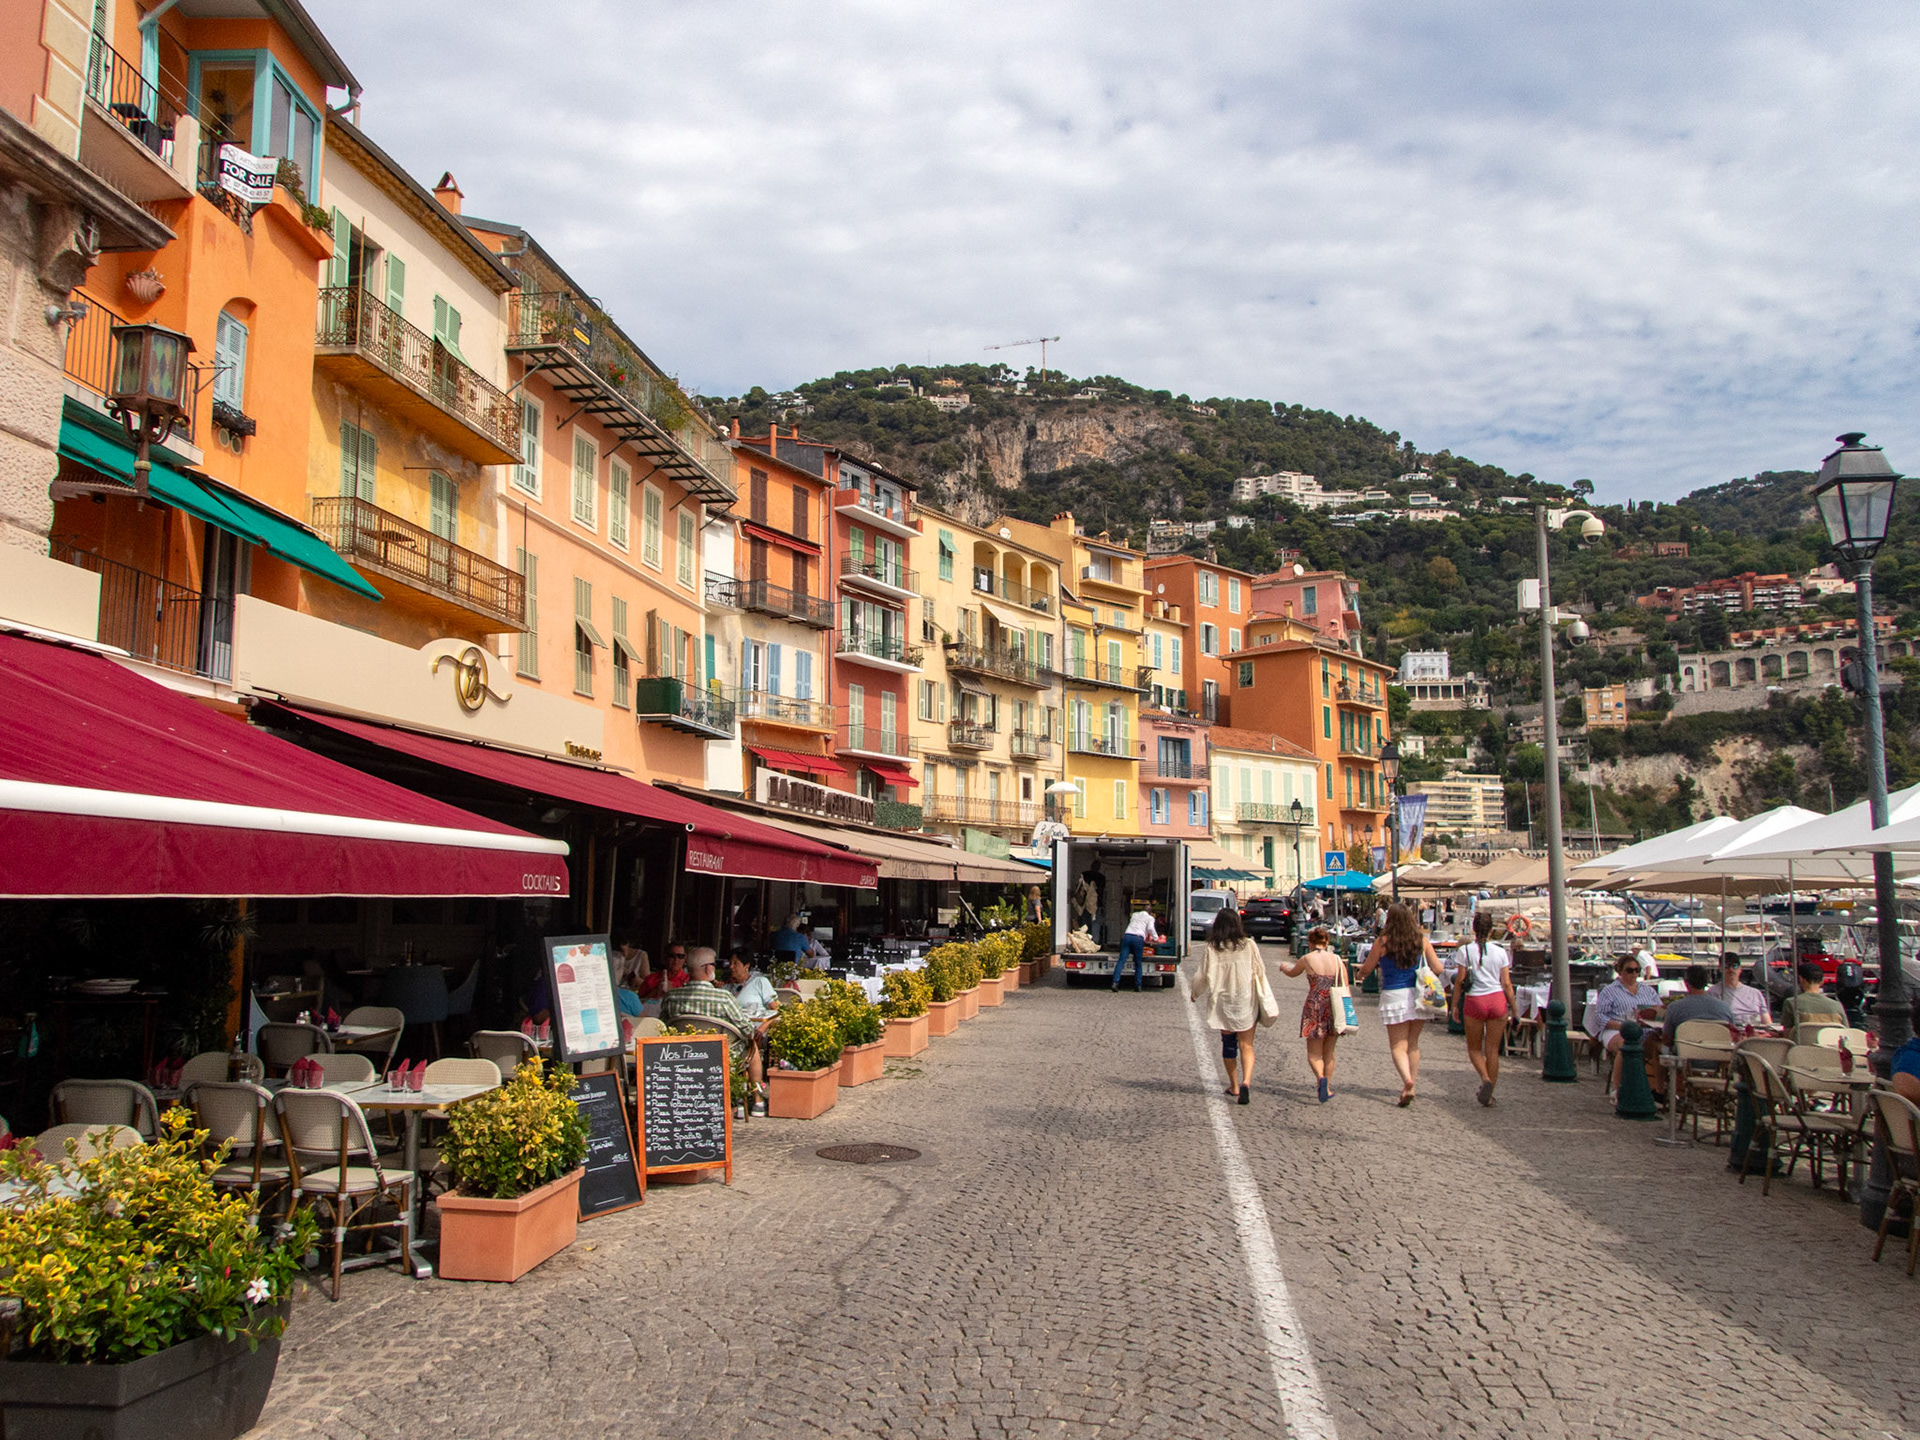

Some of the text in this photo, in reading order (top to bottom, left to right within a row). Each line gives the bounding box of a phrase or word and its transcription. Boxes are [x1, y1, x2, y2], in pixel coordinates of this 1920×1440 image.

[223, 160, 273, 187] FOR SALE
[689, 850, 725, 871] RESTAURANT
[522, 873, 561, 891] COCKTAILS
[660, 1044, 681, 1060] Nos
